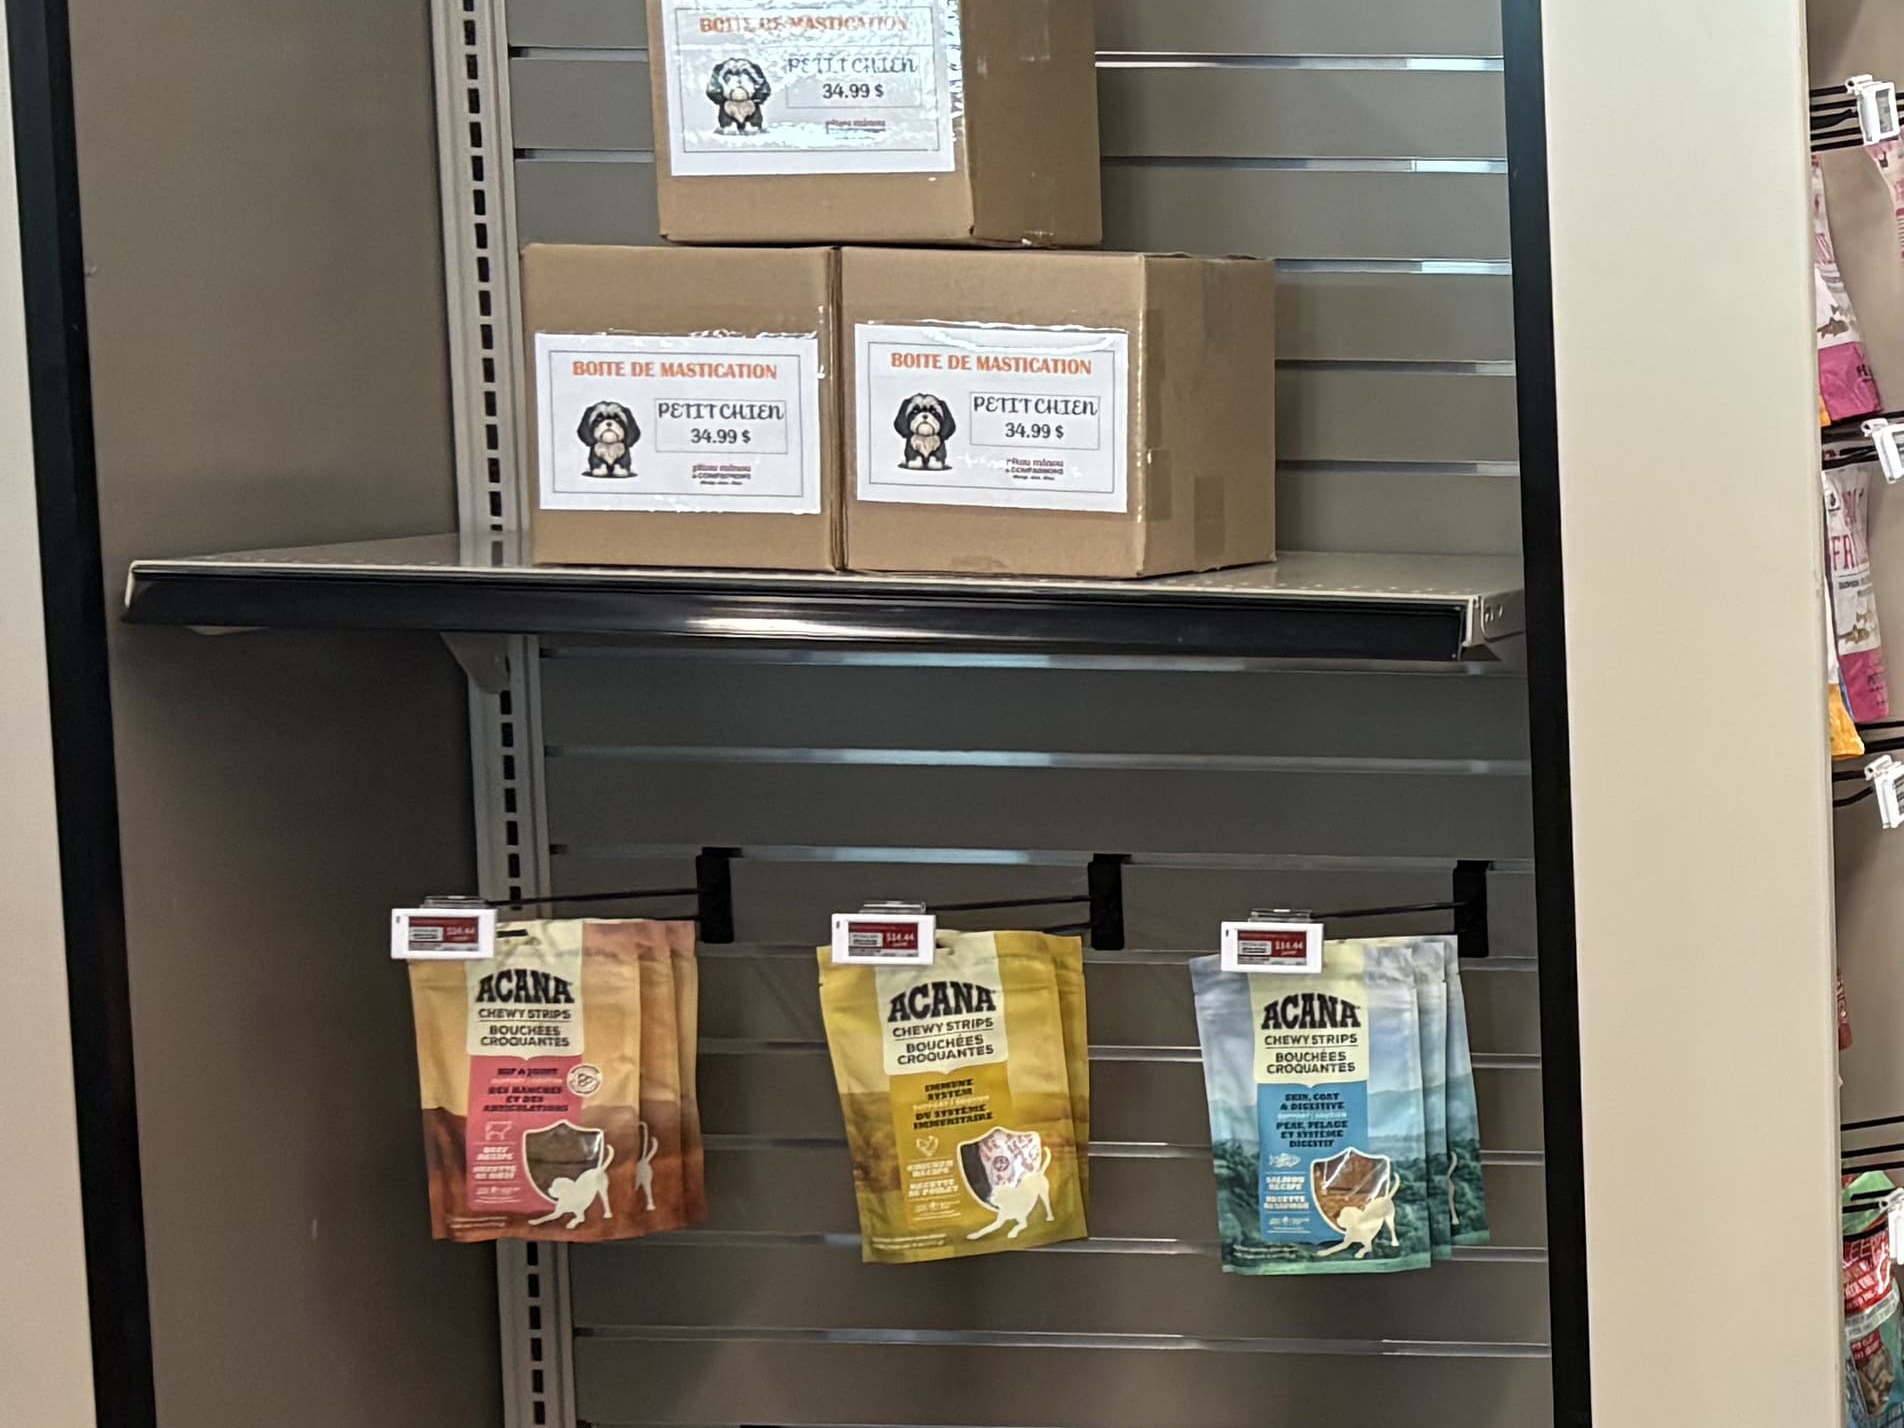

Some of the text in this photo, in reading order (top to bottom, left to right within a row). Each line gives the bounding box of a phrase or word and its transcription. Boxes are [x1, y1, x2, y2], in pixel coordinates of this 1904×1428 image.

[823, 83, 884, 99] 34.99 $
[572, 360, 778, 380] BOITE DE MASTICATION
[891, 352, 1092, 374] BOITE DE MASTICATION
[658, 402, 784, 420] PETIT CHIEN
[973, 396, 1098, 416] PETIT CHIEN
[690, 428, 751, 444] 34.99 $
[1005, 422, 1064, 439] 34.99 $
[475, 969, 575, 1004] ACANA
[888, 980, 997, 1023] ACANA
[478, 1008, 571, 1019] CHEWY STRIPS
[1261, 993, 1361, 1030] ACANA
[892, 1018, 994, 1038] CHEWY STRIPS
[480, 1036, 570, 1047] CROQUANTES
[906, 1034, 984, 1054] BOUCHÉES
[1264, 1034, 1358, 1046] CHEWY STRIPS
[897, 1045, 994, 1065] CROQUANTES
[1275, 1049, 1347, 1063] BOUCHÉES
[1266, 1062, 1356, 1074] CROQUANTES
